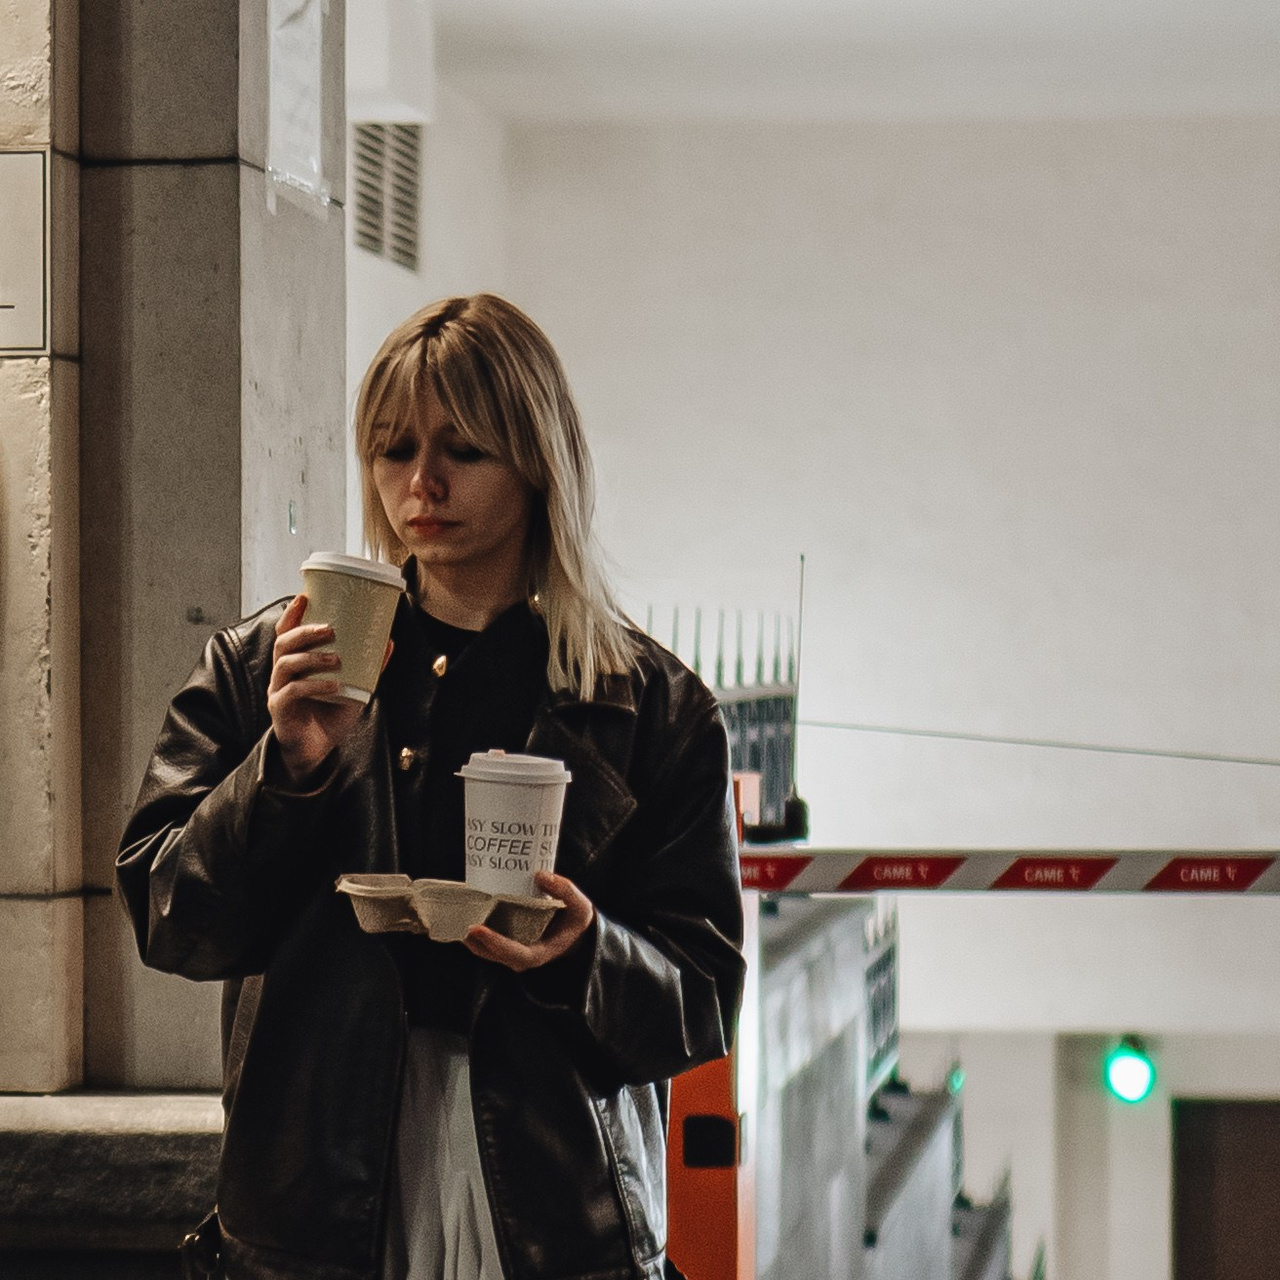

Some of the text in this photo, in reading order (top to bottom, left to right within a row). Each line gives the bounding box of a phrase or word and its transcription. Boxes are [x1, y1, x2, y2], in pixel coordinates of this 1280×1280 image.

[490, 821, 537, 836] SLOW
[467, 835, 533, 856] COFFEE
[489, 856, 532, 872] SLOW
[873, 864, 913, 881] CAME
[1024, 866, 1064, 883] CAME
[1180, 866, 1220, 883] CAME
